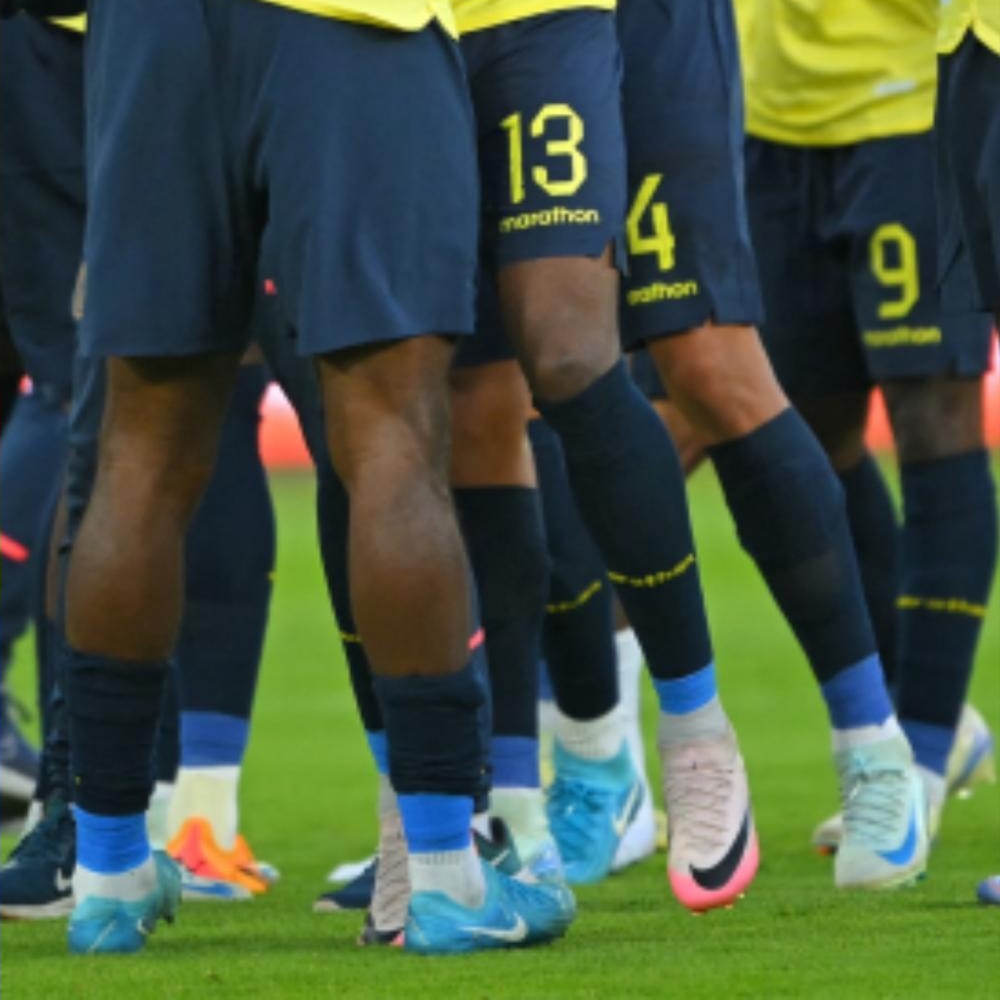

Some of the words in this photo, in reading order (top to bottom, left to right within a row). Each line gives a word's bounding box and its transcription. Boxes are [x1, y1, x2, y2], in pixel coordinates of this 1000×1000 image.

[500, 102, 588, 204] 13
[499, 205, 600, 234] marathon
[626, 172, 676, 271] 4
[869, 221, 920, 320] 9
